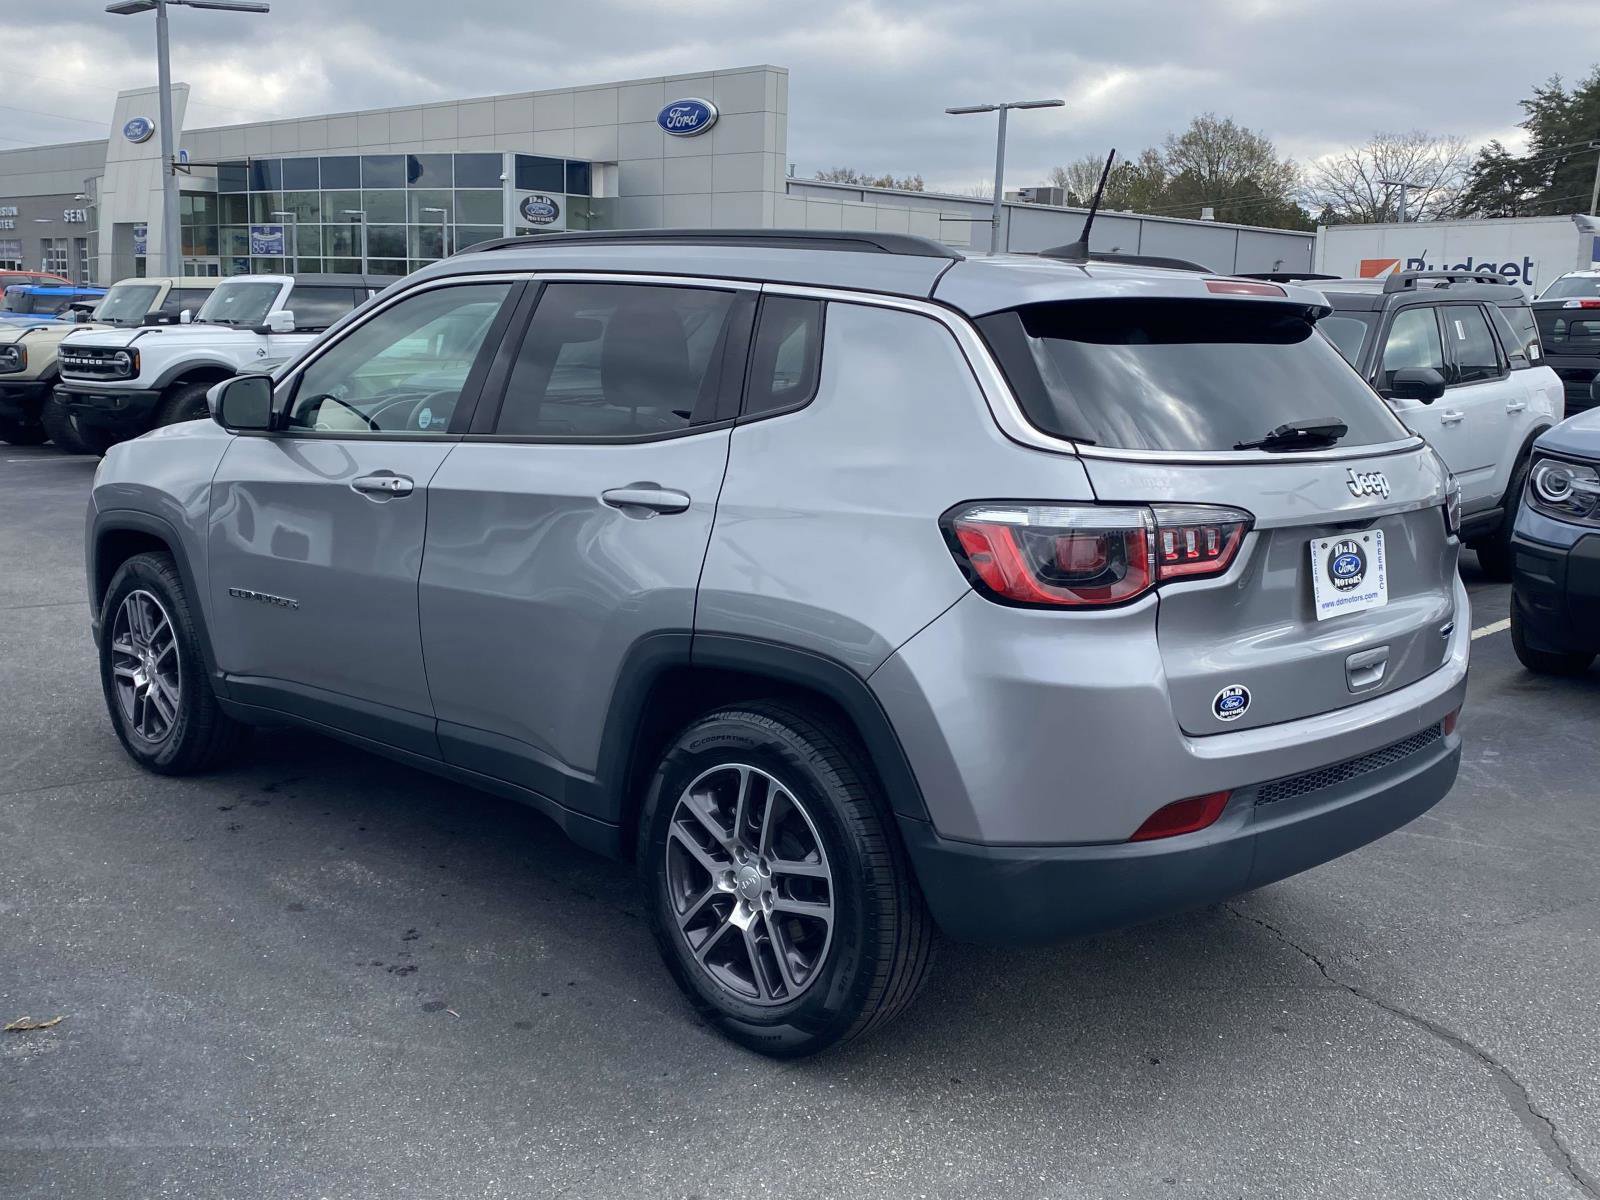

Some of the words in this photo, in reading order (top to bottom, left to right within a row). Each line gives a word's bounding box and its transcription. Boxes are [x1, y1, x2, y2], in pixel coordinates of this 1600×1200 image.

[667, 107, 699, 128] Ford
[127, 122, 144, 136] Ford
[0, 207, 18, 216] SION
[1346, 468, 1391, 500] Jeep
[1334, 541, 1358, 558] D&D
[1338, 558, 1356, 574] Ford
[1334, 573, 1362, 588] MOTORS
[1321, 591, 1379, 609] www.ddmotors.com
[1220, 706, 1245, 717] MOTORS
